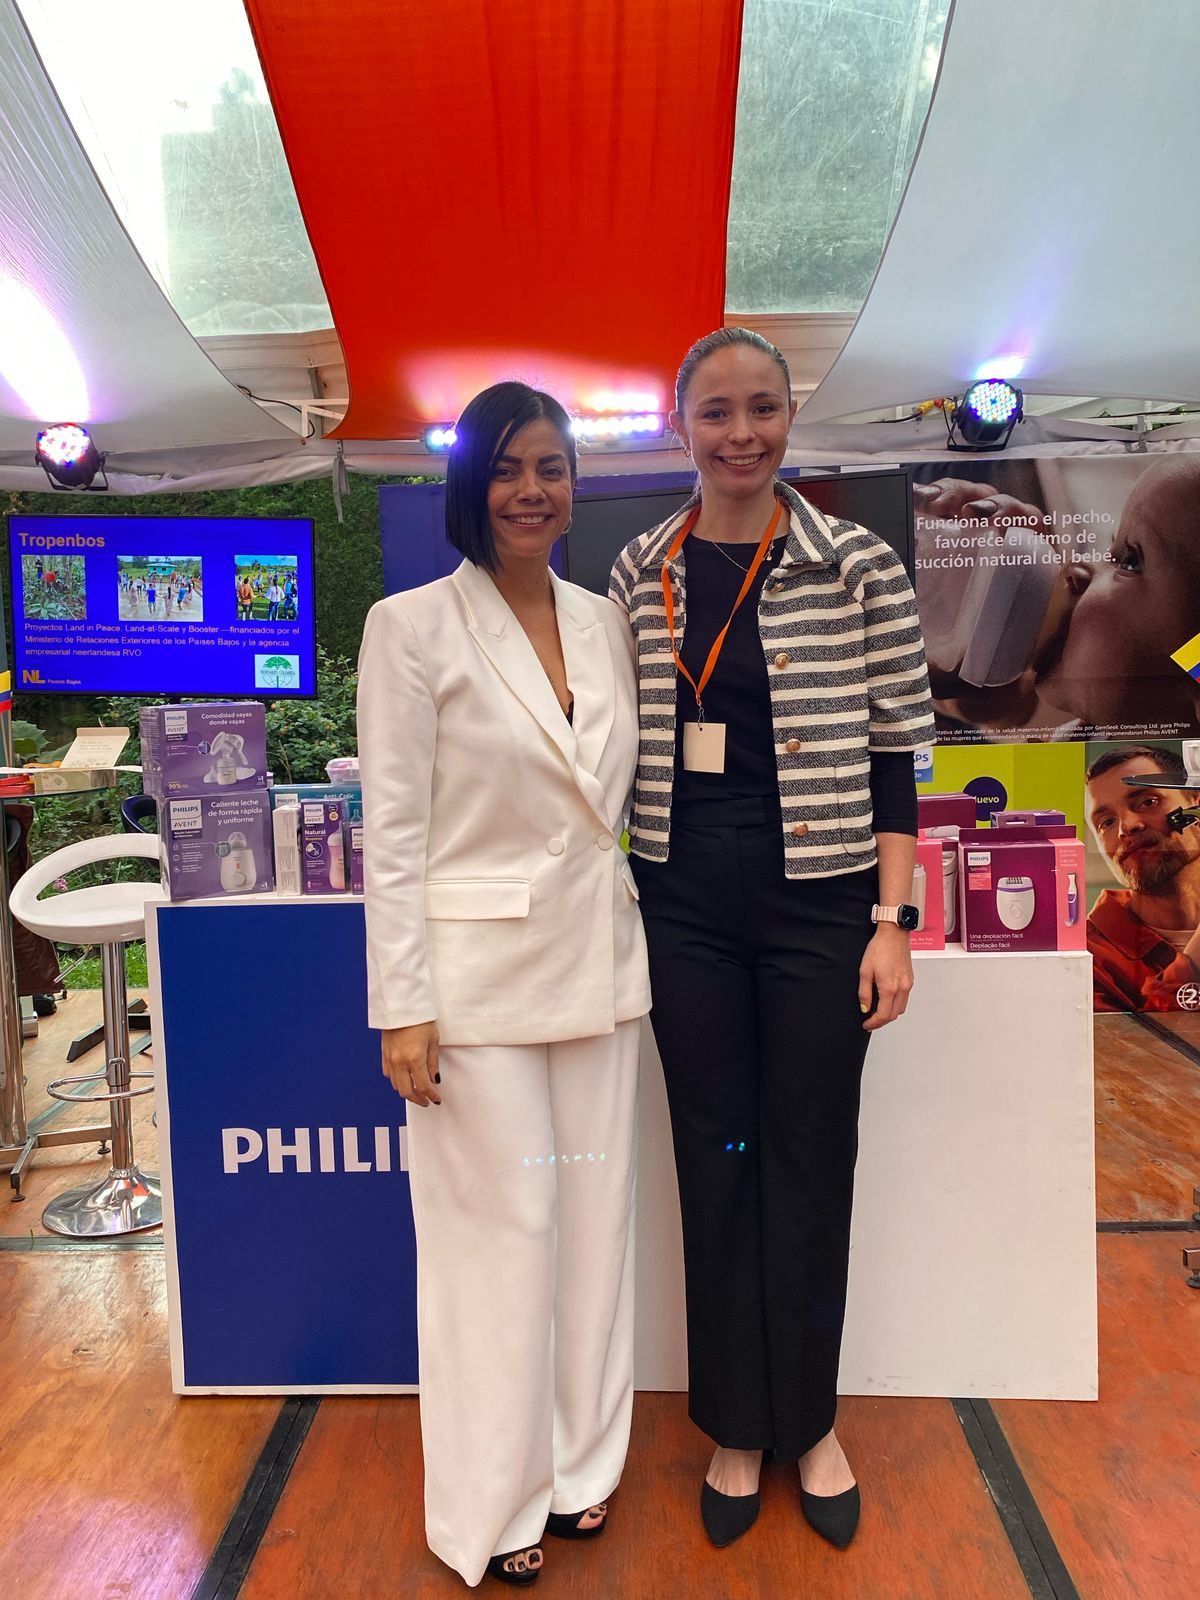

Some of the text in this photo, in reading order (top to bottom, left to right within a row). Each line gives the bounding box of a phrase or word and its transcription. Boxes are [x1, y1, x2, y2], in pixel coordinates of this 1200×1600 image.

[916, 509, 1115, 530] Funciona como el pecho,
[18, 532, 106, 550] Tropenbos
[934, 528, 1097, 549] favorece el ritmo de
[914, 546, 1116, 570] succión natural del bebé.
[24, 623, 64, 632] Proyectos
[87, 624, 94, 632] in
[125, 624, 180, 633] Land-at-Scale
[182, 626, 187, 634] y
[188, 625, 219, 633] Booster
[25, 635, 62, 643] Ministerio
[76, 635, 119, 644] Relaciones
[121, 636, 161, 645] Exteriores
[174, 637, 187, 645] los
[217, 638, 240, 647] Bajos
[258, 639, 289, 647] agencia
[25, 648, 71, 657] empresarial
[72, 648, 121, 656] neerlandesa
[22, 669, 46, 684] NL
[201, 712, 236, 720] Comodidad
[1120, 723, 1148, 731] Consulting
[210, 800, 240, 808] Caliente
[976, 795, 1000, 804] uevo
[174, 820, 197, 828] AVENT
[217, 816, 254, 826] y uniforme
